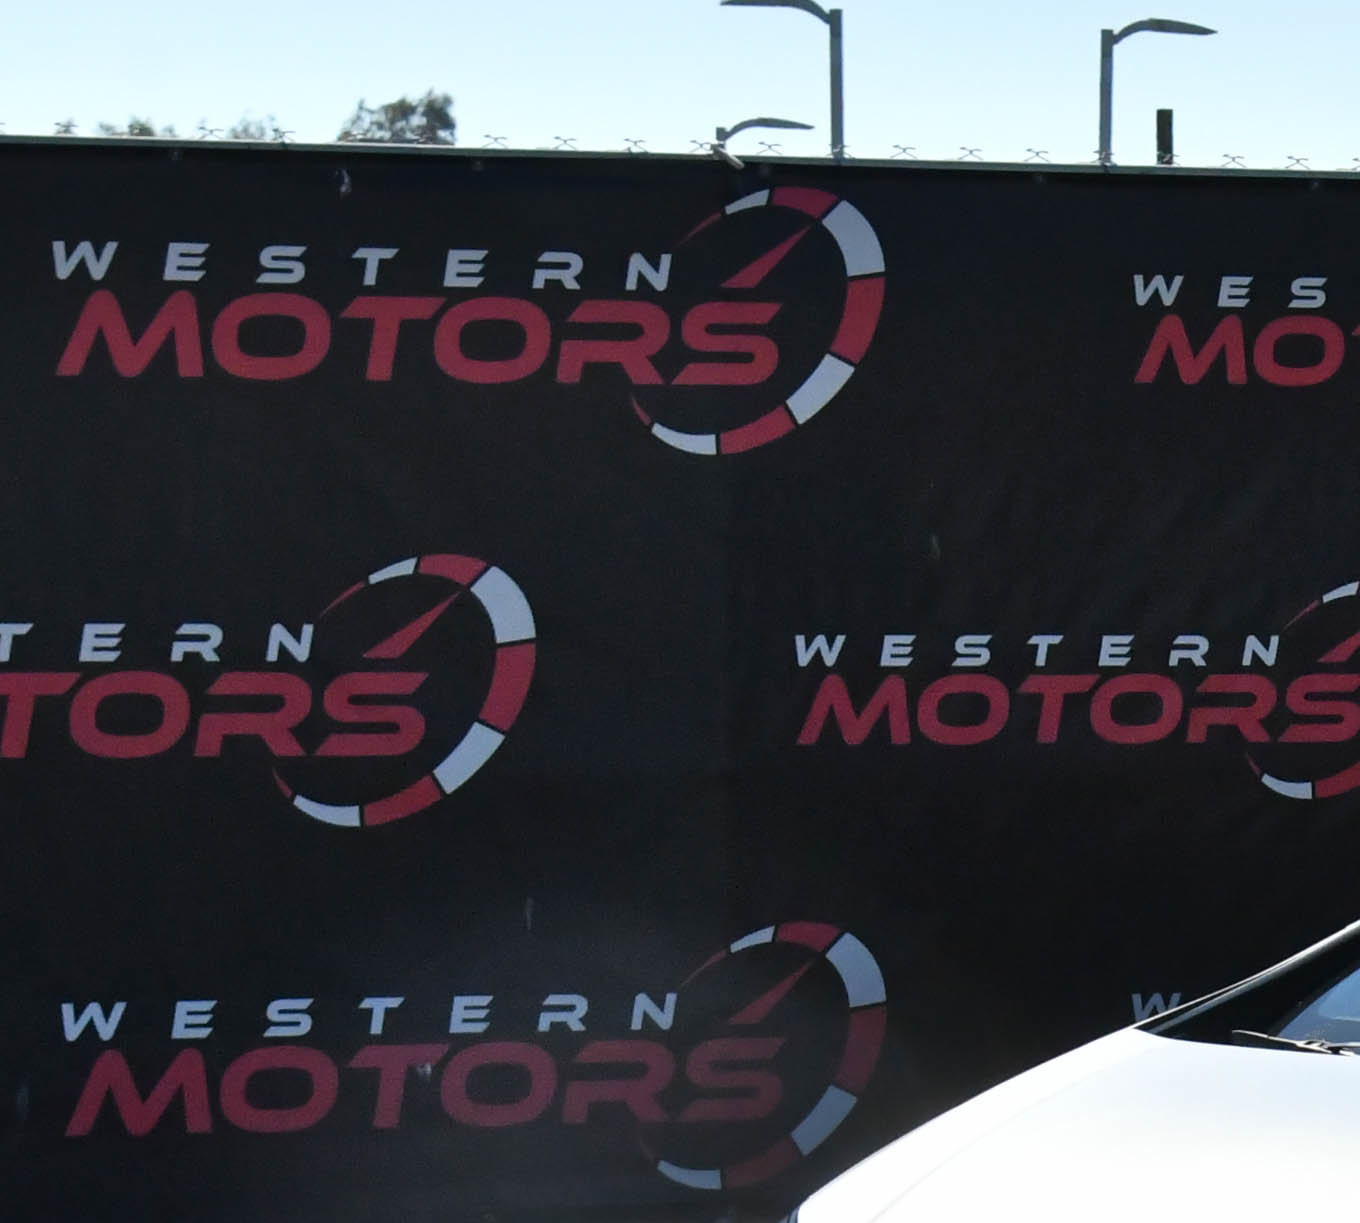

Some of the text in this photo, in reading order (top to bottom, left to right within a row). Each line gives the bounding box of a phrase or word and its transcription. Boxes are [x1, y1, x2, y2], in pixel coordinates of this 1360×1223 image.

[53, 240, 671, 292] WESTERN
[57, 289, 782, 385] MOTORS
[795, 634, 1279, 667] WESTERN
[61, 992, 677, 1042] WESTERN
[66, 1039, 784, 1137] MOTORS
